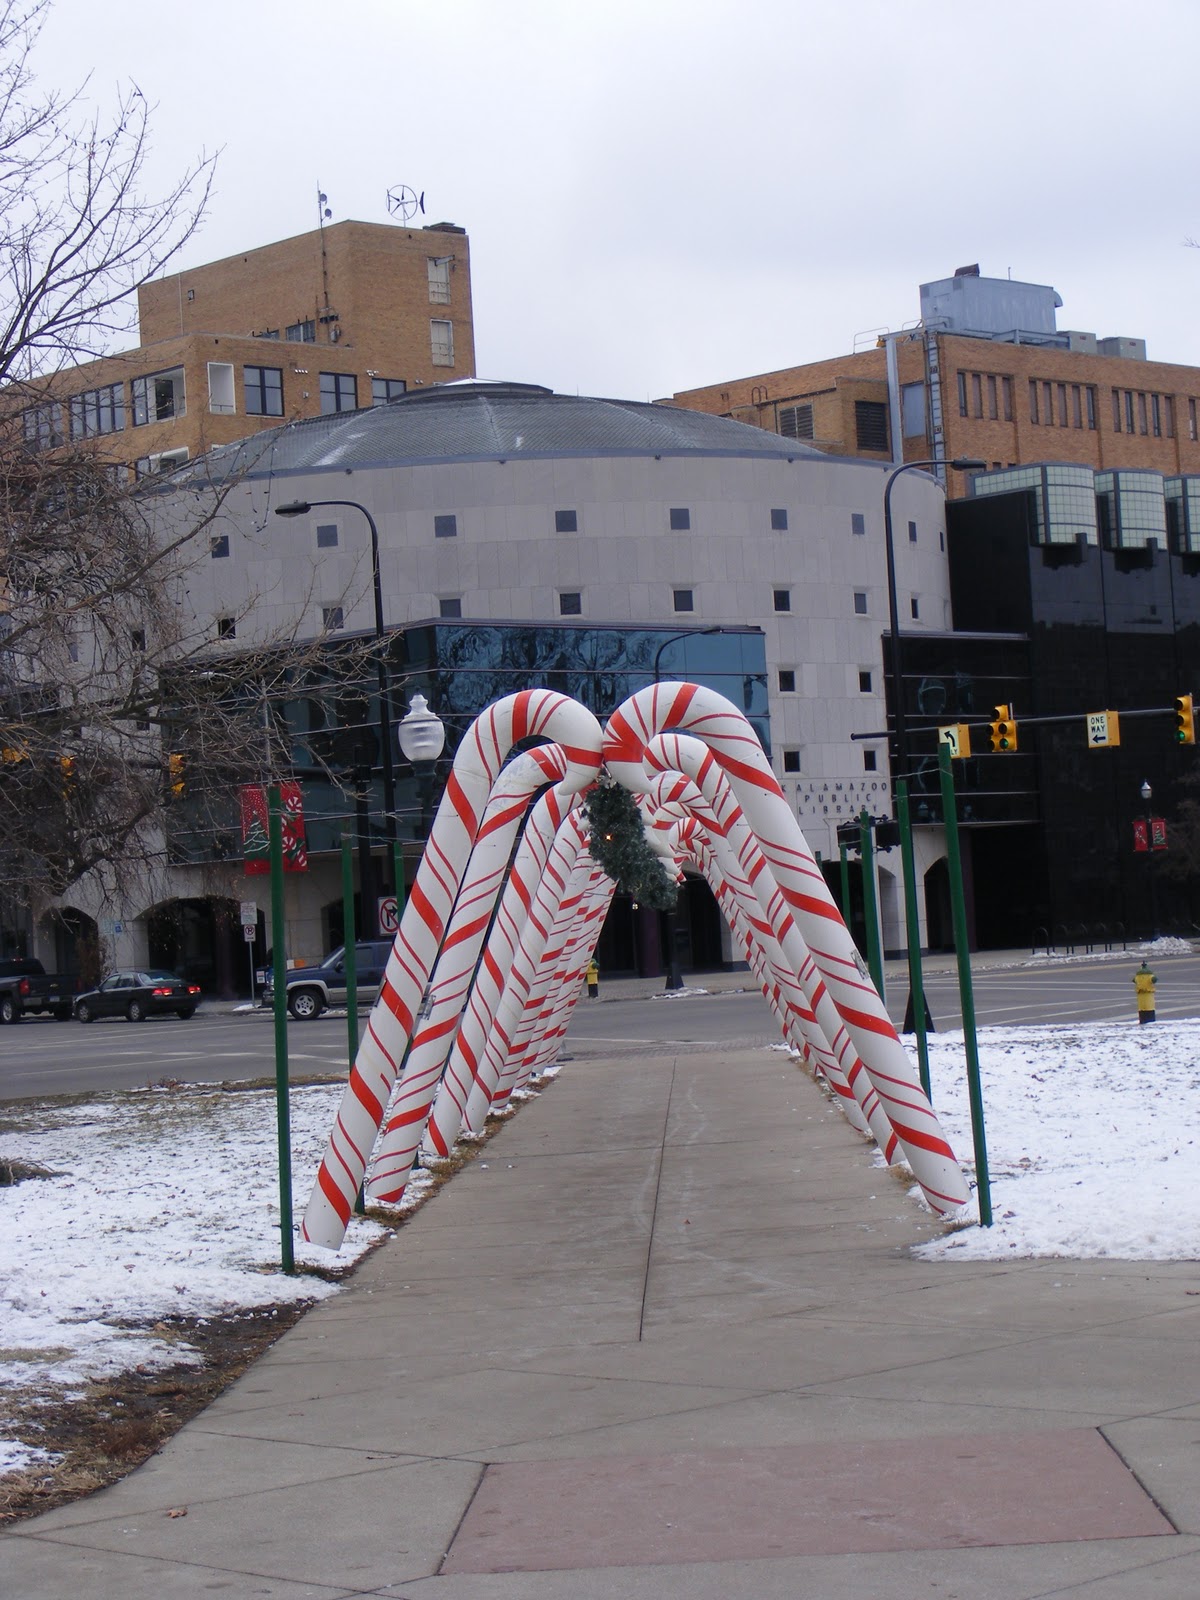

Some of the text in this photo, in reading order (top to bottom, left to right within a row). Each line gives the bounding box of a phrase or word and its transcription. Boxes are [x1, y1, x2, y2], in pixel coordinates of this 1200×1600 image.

[1090, 715, 1104, 725] ONE
[1091, 725, 1105, 733] WAY
[781, 782, 887, 793] KALAMAZOO
[804, 793, 871, 803] PUBLIC
[798, 804, 877, 815] LIBRARY
